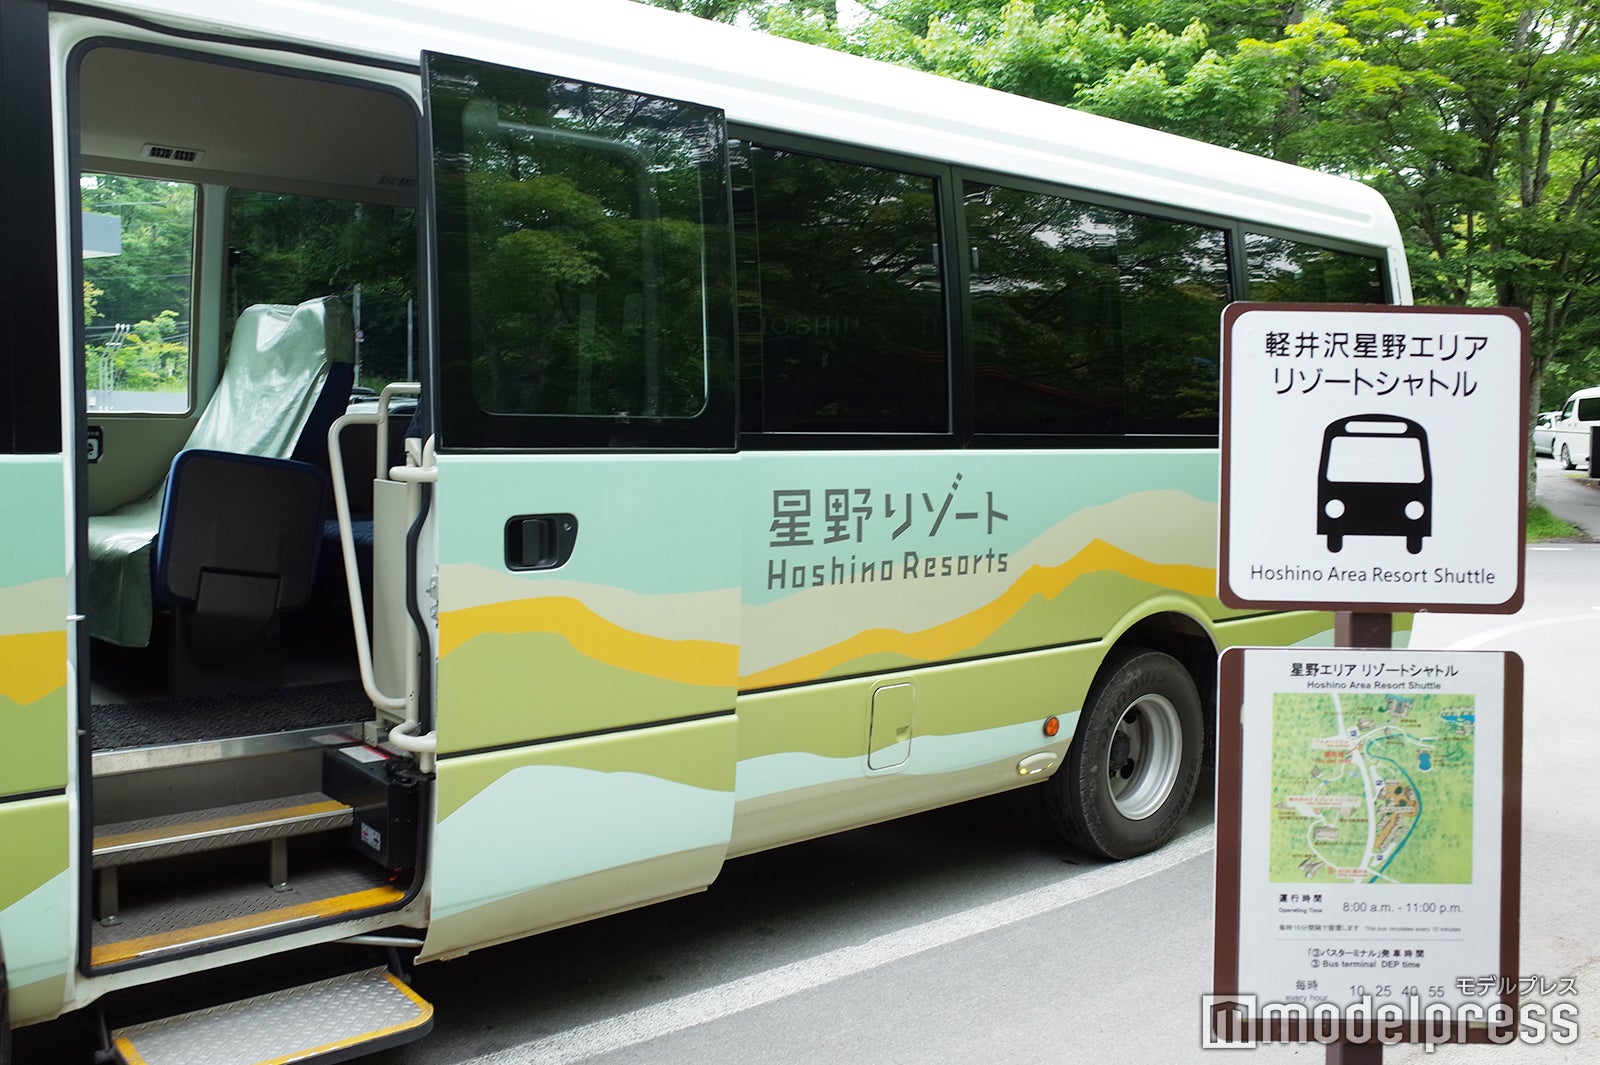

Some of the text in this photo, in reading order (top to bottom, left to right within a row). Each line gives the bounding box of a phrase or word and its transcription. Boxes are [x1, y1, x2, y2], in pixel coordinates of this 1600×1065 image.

[1265, 331, 1488, 361] 軽井沢星野エリア
[1275, 367, 1478, 397] リゾートシャトル
[769, 472, 1009, 548] 星野リゾート
[767, 547, 1009, 590] Hoshino Resorts
[1251, 565, 1496, 584] Hoshino Area Resort Shuttle
[1290, 662, 1459, 677] 星野エリア リゾートシャトル
[1307, 680, 1442, 690] Hoshino Area Resort Shuttle
[1279, 893, 1323, 903] 運行時間
[1343, 902, 1367, 913] 8:00
[1370, 904, 1394, 913] a.m.
[1406, 902, 1437, 913] 11:00
[1439, 904, 1464, 914] p.m.
[1322, 959, 1339, 968] Bus
[1341, 959, 1377, 968] terminal
[1381, 960, 1400, 968] DEP
[1402, 960, 1421, 968] time
[1296, 980, 1319, 991] 毎時
[1350, 986, 1445, 998] 10 25 40 55
[1285, 994, 1328, 1003] every hour
